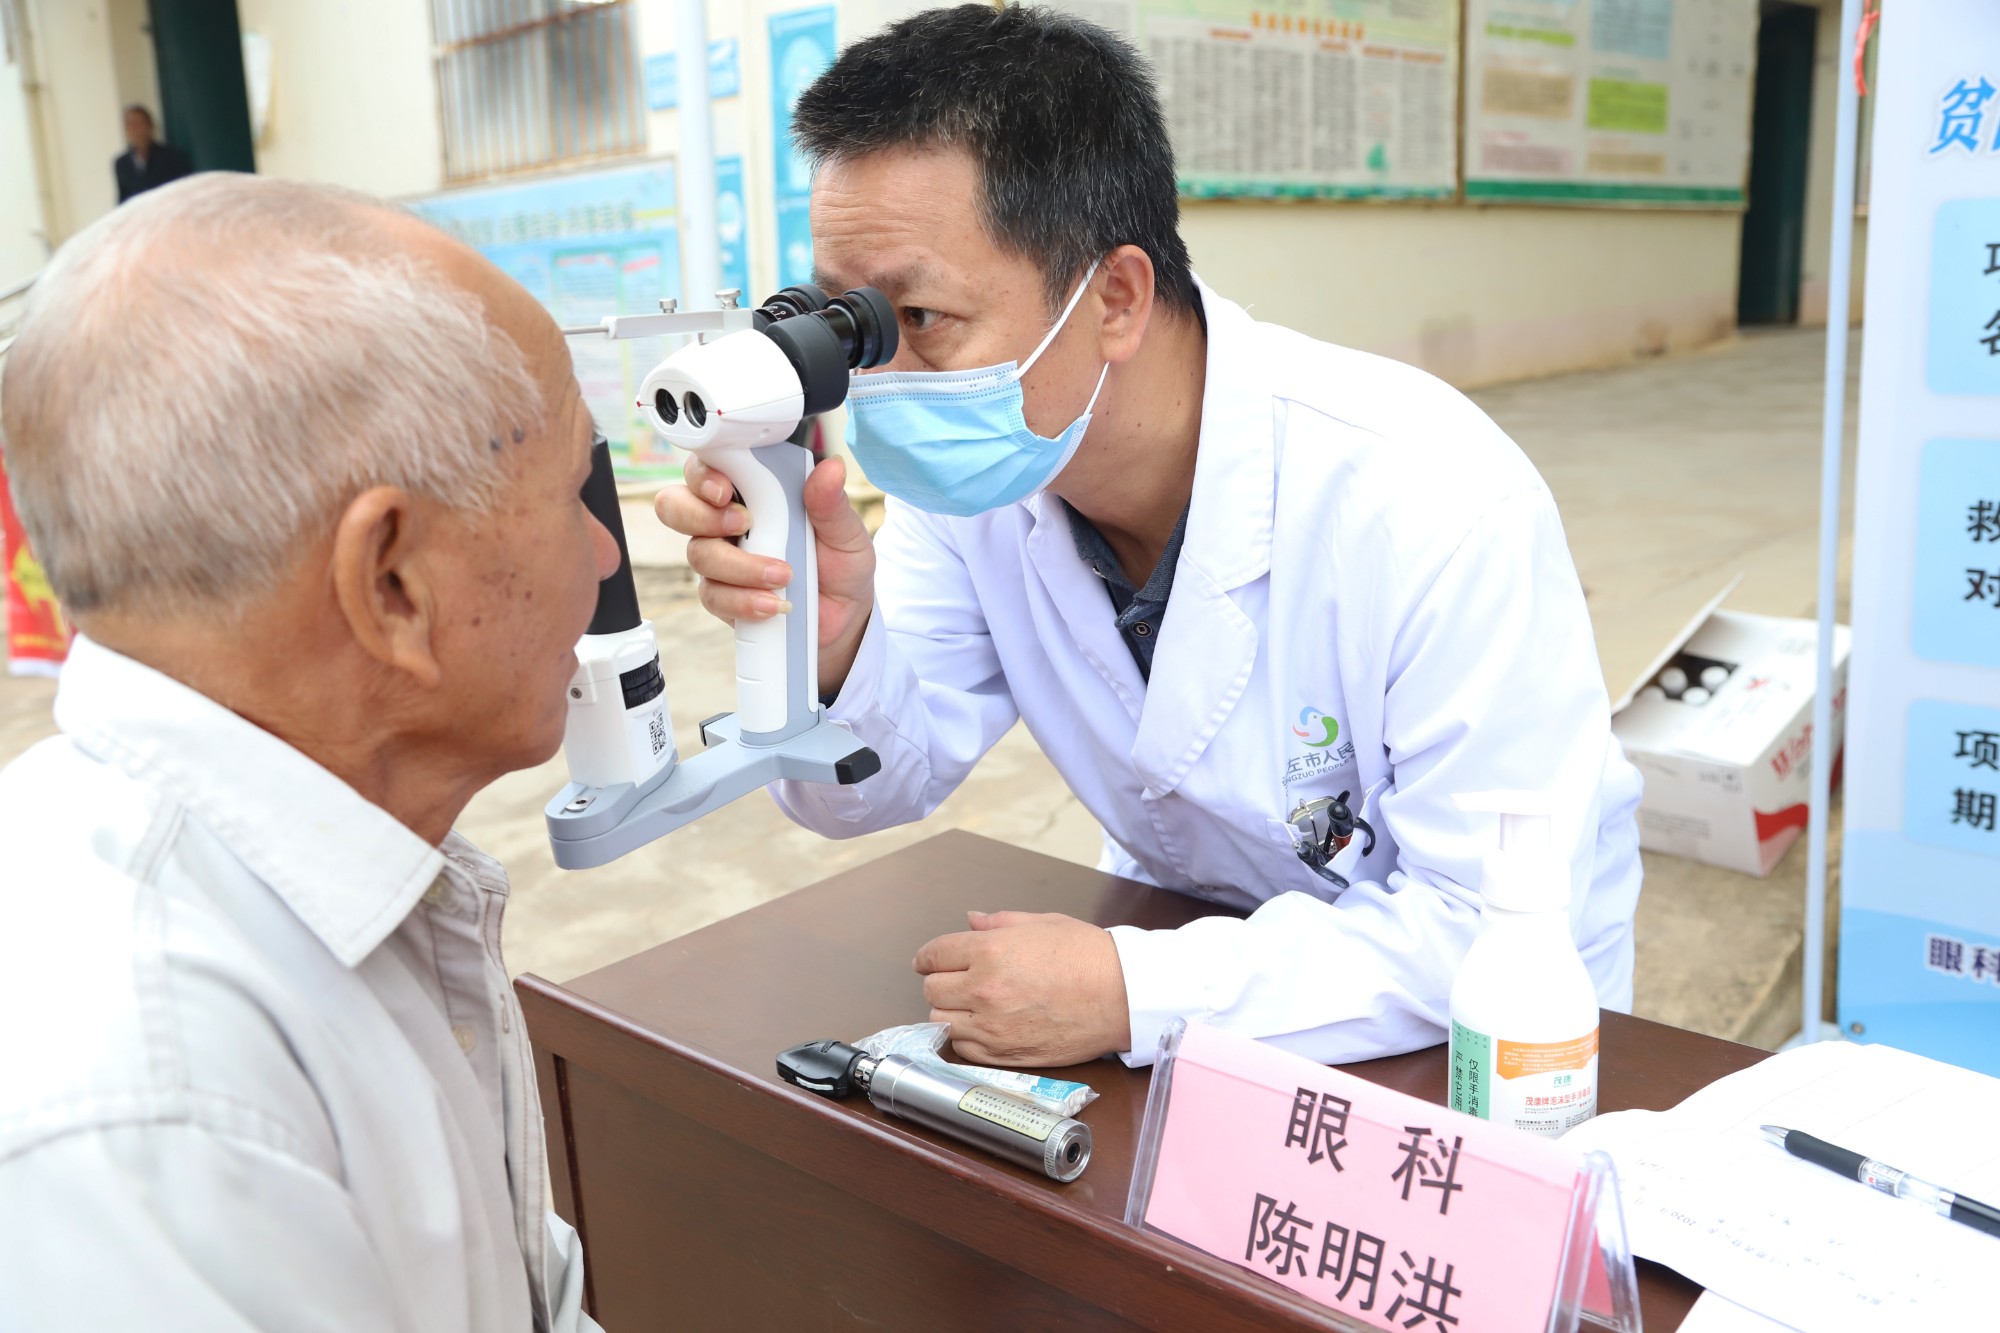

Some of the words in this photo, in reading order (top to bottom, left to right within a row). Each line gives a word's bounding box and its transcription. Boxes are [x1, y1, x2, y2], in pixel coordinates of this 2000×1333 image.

[1929, 75, 2000, 153] 贫
[1953, 730, 2000, 770] 项
[1951, 787, 1997, 831] 期
[1928, 937, 2000, 984] 眼科
[1284, 1086, 1464, 1216] 眼科
[1245, 1192, 1463, 1333] 陈明洪
